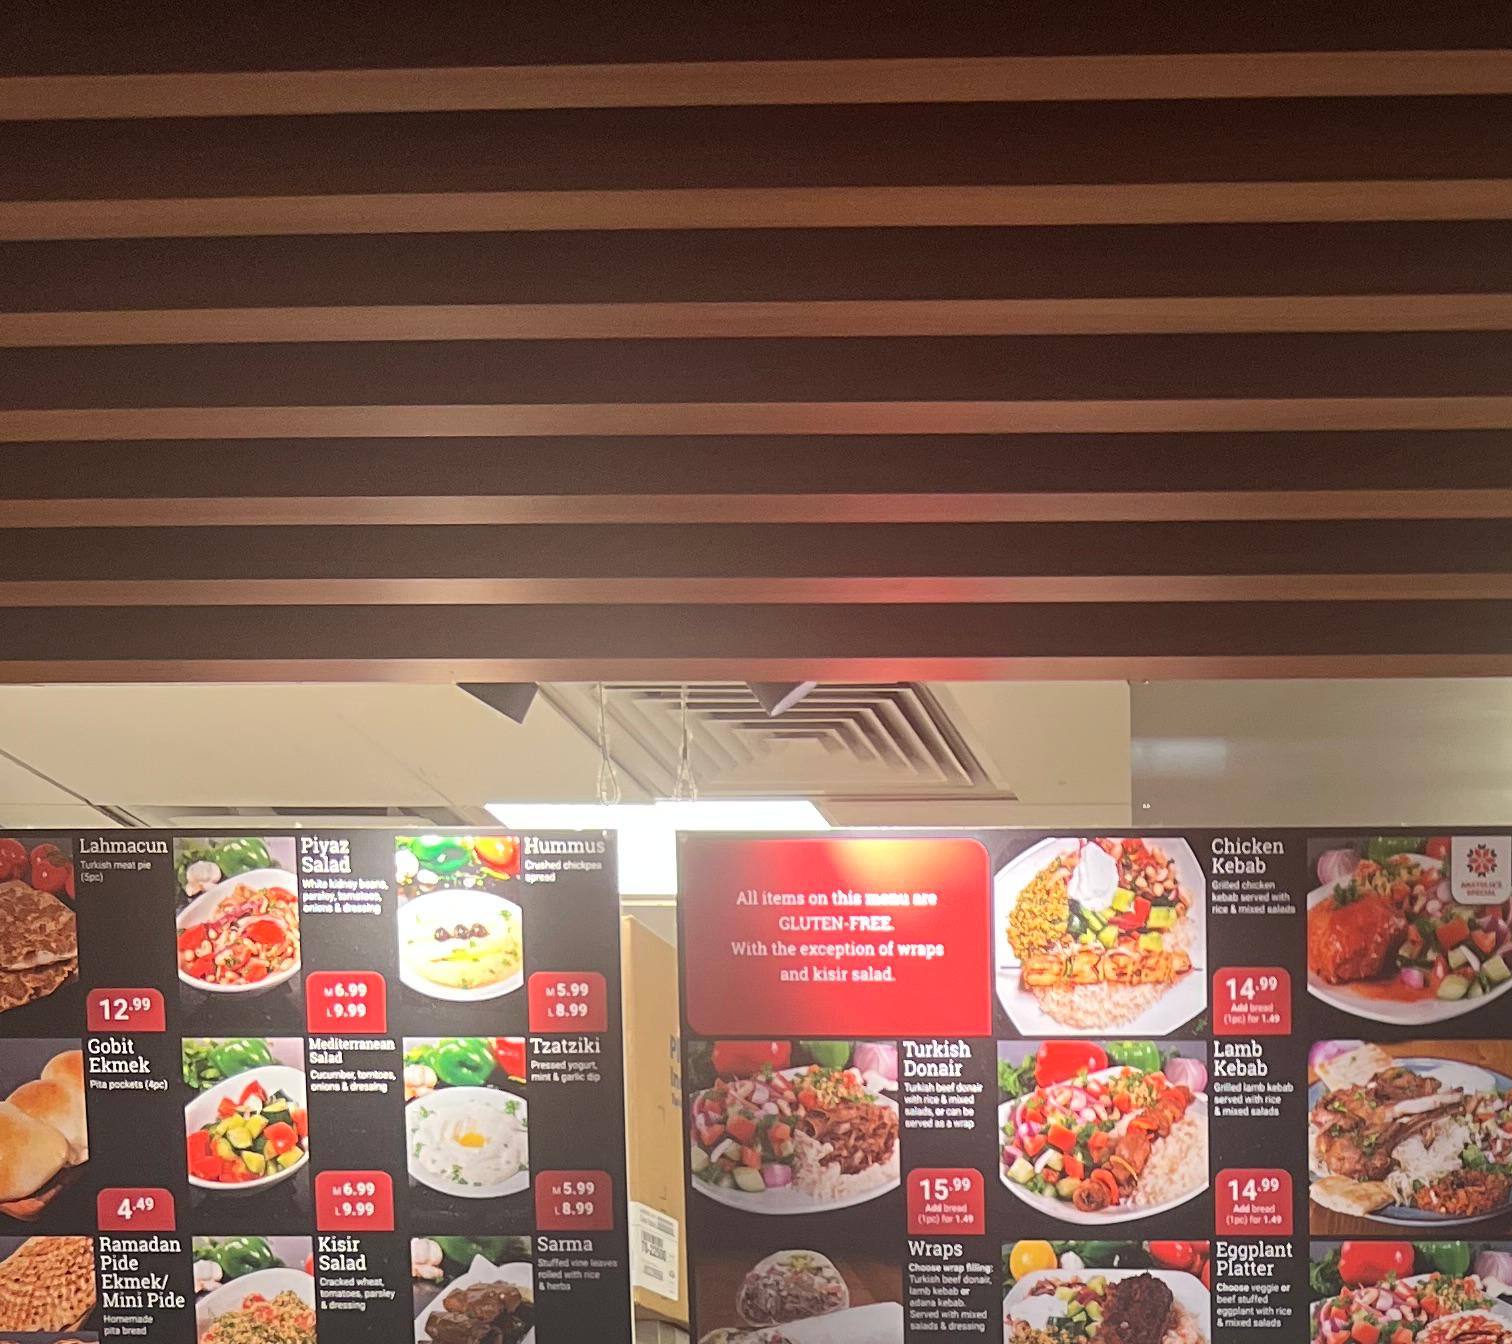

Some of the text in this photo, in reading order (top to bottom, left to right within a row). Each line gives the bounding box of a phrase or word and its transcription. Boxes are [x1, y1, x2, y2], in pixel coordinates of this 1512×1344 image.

[80, 837, 168, 853] Lahmacun
[301, 836, 349, 858] Piyaz
[524, 837, 605, 854] Hummus
[1212, 837, 1284, 854] Chicken
[302, 856, 351, 873] Salad
[1212, 857, 1266, 874] Kebab
[736, 889, 758, 905] All
[762, 891, 805, 905] items
[808, 894, 828, 905] on
[832, 890, 862, 905] this
[731, 940, 944, 960] With the exception of wraps
[781, 966, 896, 982] and kisir salad.
[335, 983, 367, 997] 6.99
[1226, 976, 1277, 1000] 14.99
[100, 997, 150, 1020] 12.99
[334, 1003, 366, 1017] 9.99
[88, 1038, 134, 1054] Gobit
[309, 1037, 395, 1050] Mediterranean
[530, 1037, 600, 1054] Tzatziki
[903, 1040, 972, 1060] Turkish
[1214, 1039, 1262, 1060] Lamb
[89, 1056, 150, 1073] Ekmek
[310, 1051, 343, 1064] Salad
[904, 1059, 963, 1077] Donair
[1214, 1059, 1267, 1076] Kebab
[90, 1079, 168, 1090] Pita pockets (4pc)
[920, 1177, 971, 1200] 15.99
[1228, 1178, 1279, 1201] 14.99
[117, 1197, 154, 1219] 4.49
[99, 1236, 181, 1252] Ramadan
[318, 1236, 360, 1255] Kisir
[538, 1236, 593, 1251] Sarma
[908, 1240, 963, 1260] Wraps
[1216, 1241, 1293, 1262] Eggplant
[100, 1255, 138, 1271] Pide
[319, 1254, 367, 1271] Salad
[1217, 1259, 1274, 1276] Platter
[101, 1273, 168, 1290] Ekmek/
[102, 1291, 185, 1308] Mini Pide
